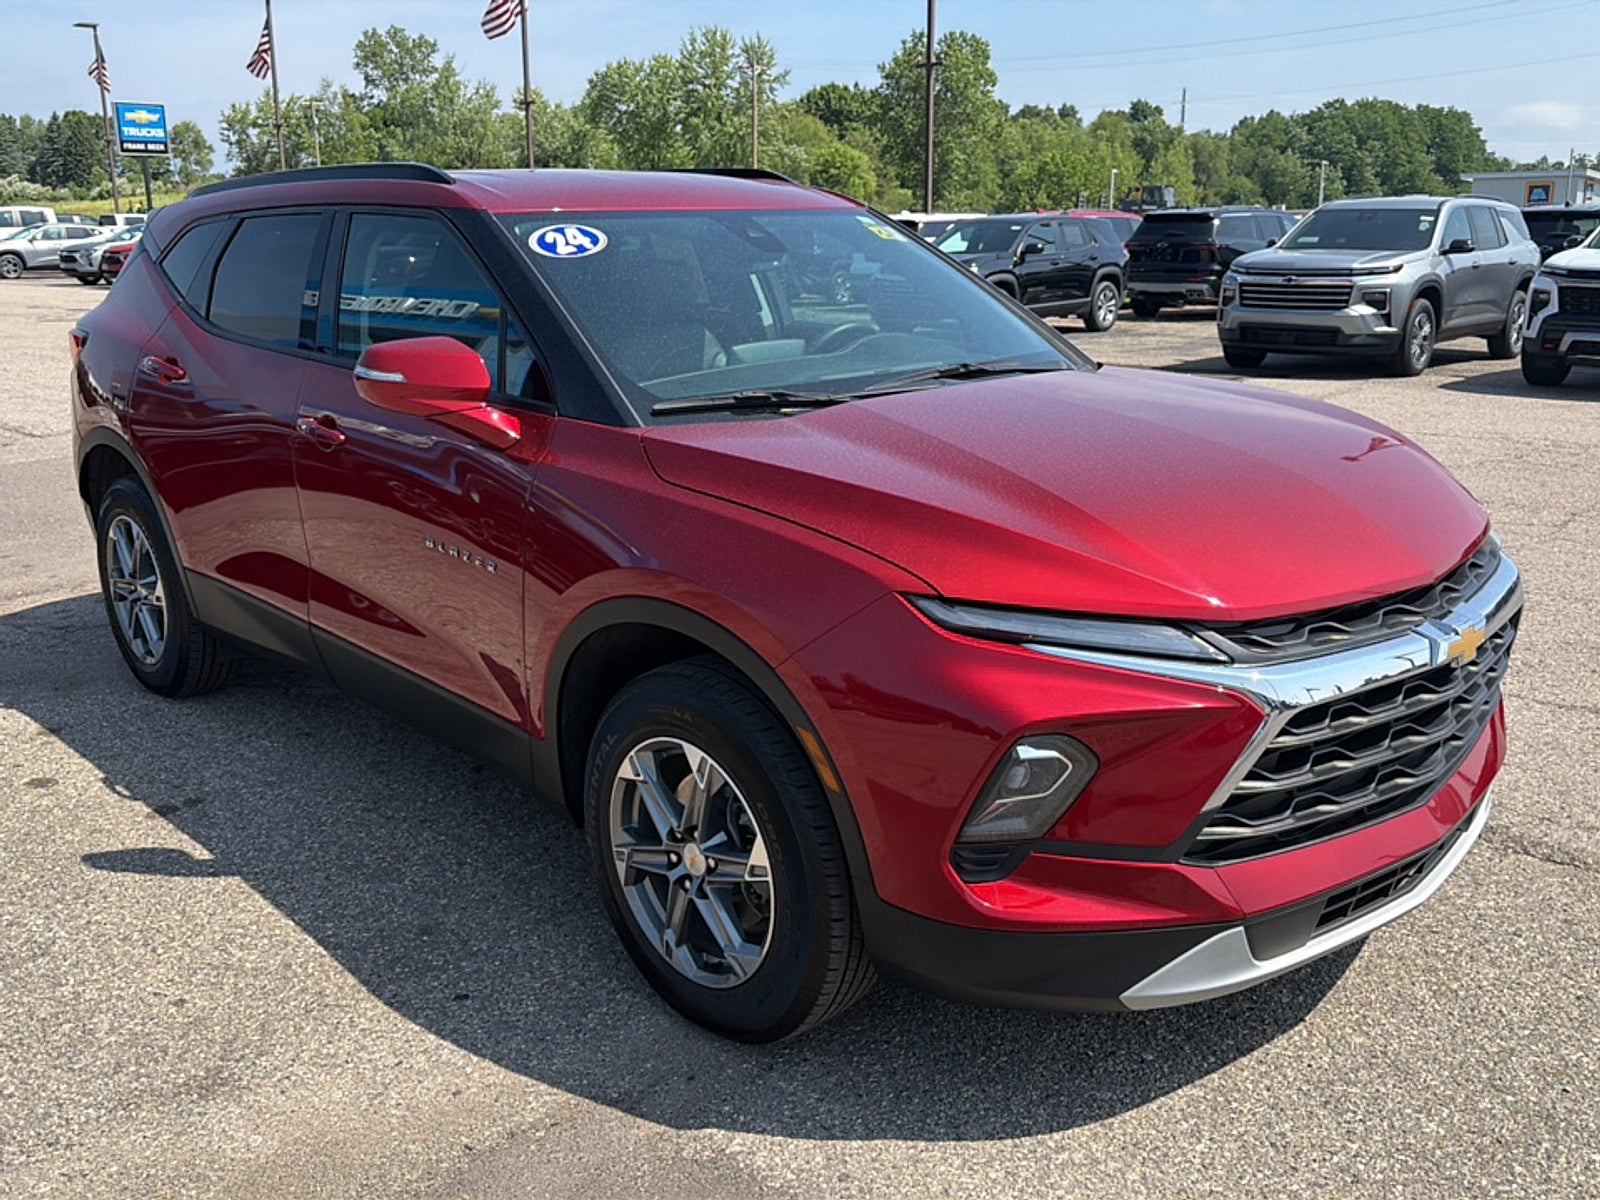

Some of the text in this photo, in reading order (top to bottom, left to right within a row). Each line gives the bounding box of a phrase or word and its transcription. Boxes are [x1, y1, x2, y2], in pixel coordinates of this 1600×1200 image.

[122, 127, 165, 137] TRUCKS
[544, 227, 595, 254] 24
[425, 536, 497, 575] BLAZER
